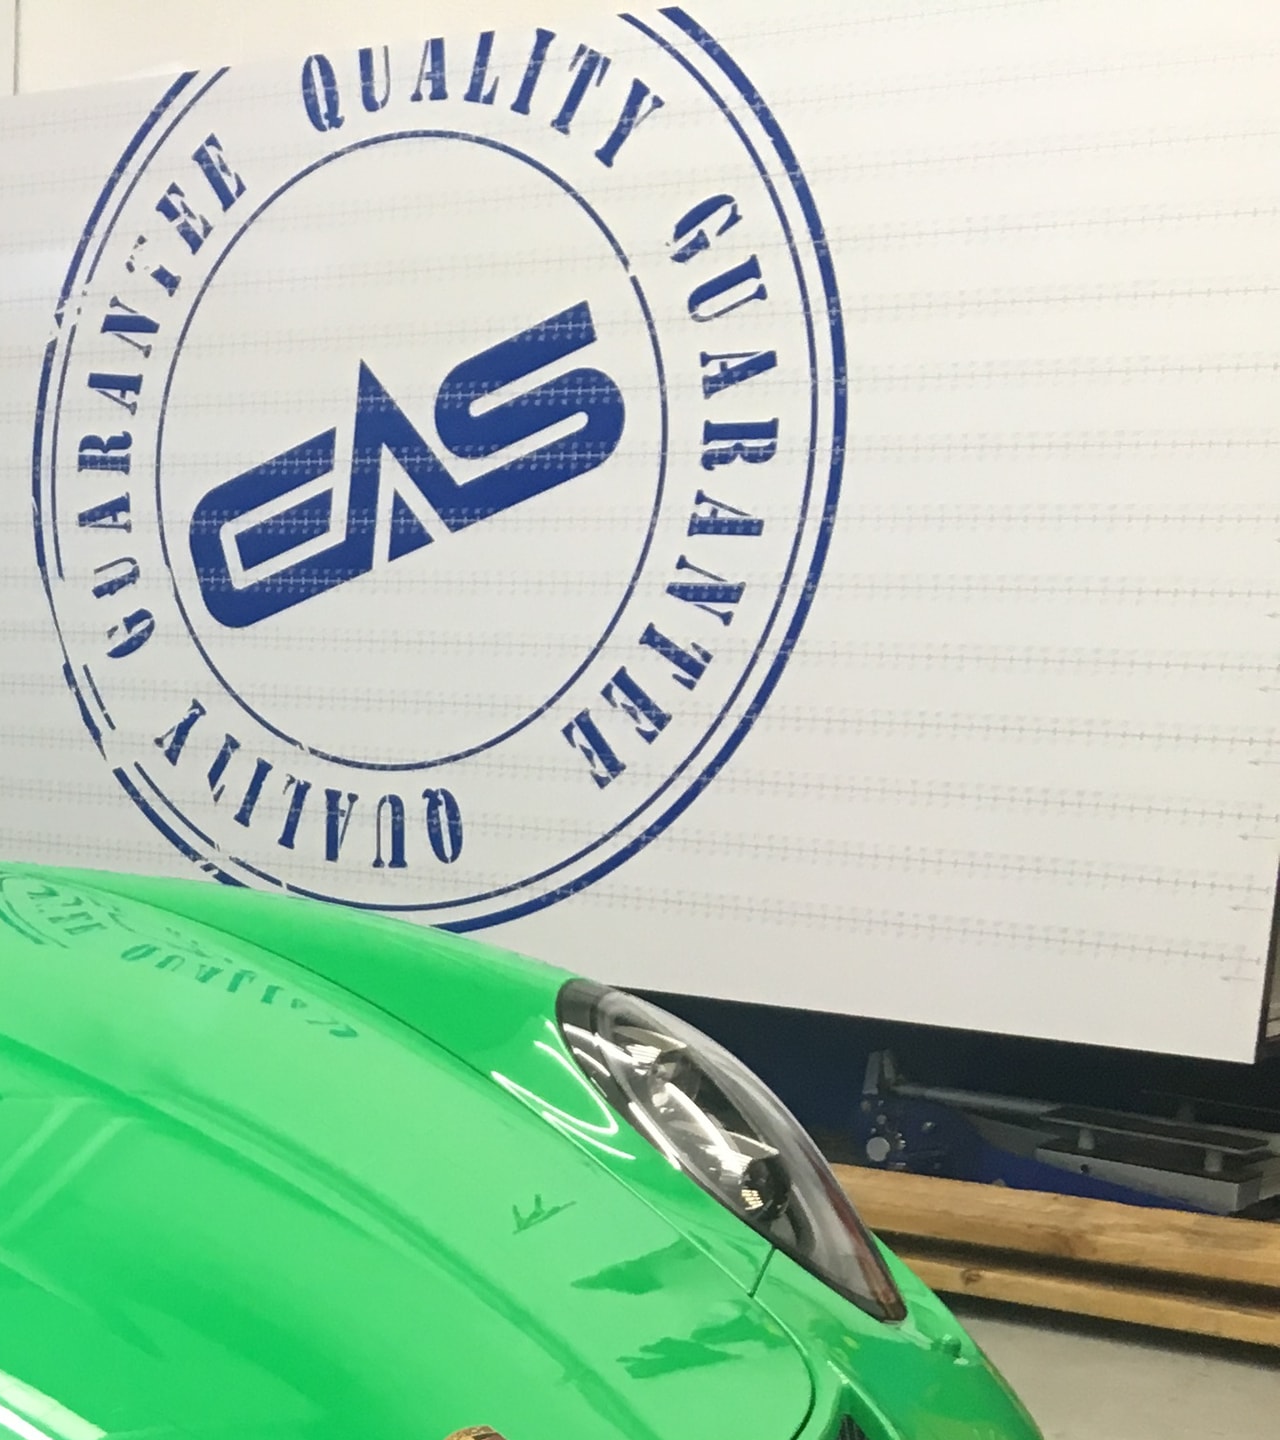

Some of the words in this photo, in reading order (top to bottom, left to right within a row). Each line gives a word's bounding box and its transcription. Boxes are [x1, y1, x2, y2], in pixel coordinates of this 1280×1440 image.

[76, 131, 250, 660] GUARANTEE
[299, 27, 668, 168] QUALITY
[565, 193, 781, 791] GUARANTEE
[153, 698, 464, 869] QUALITY
